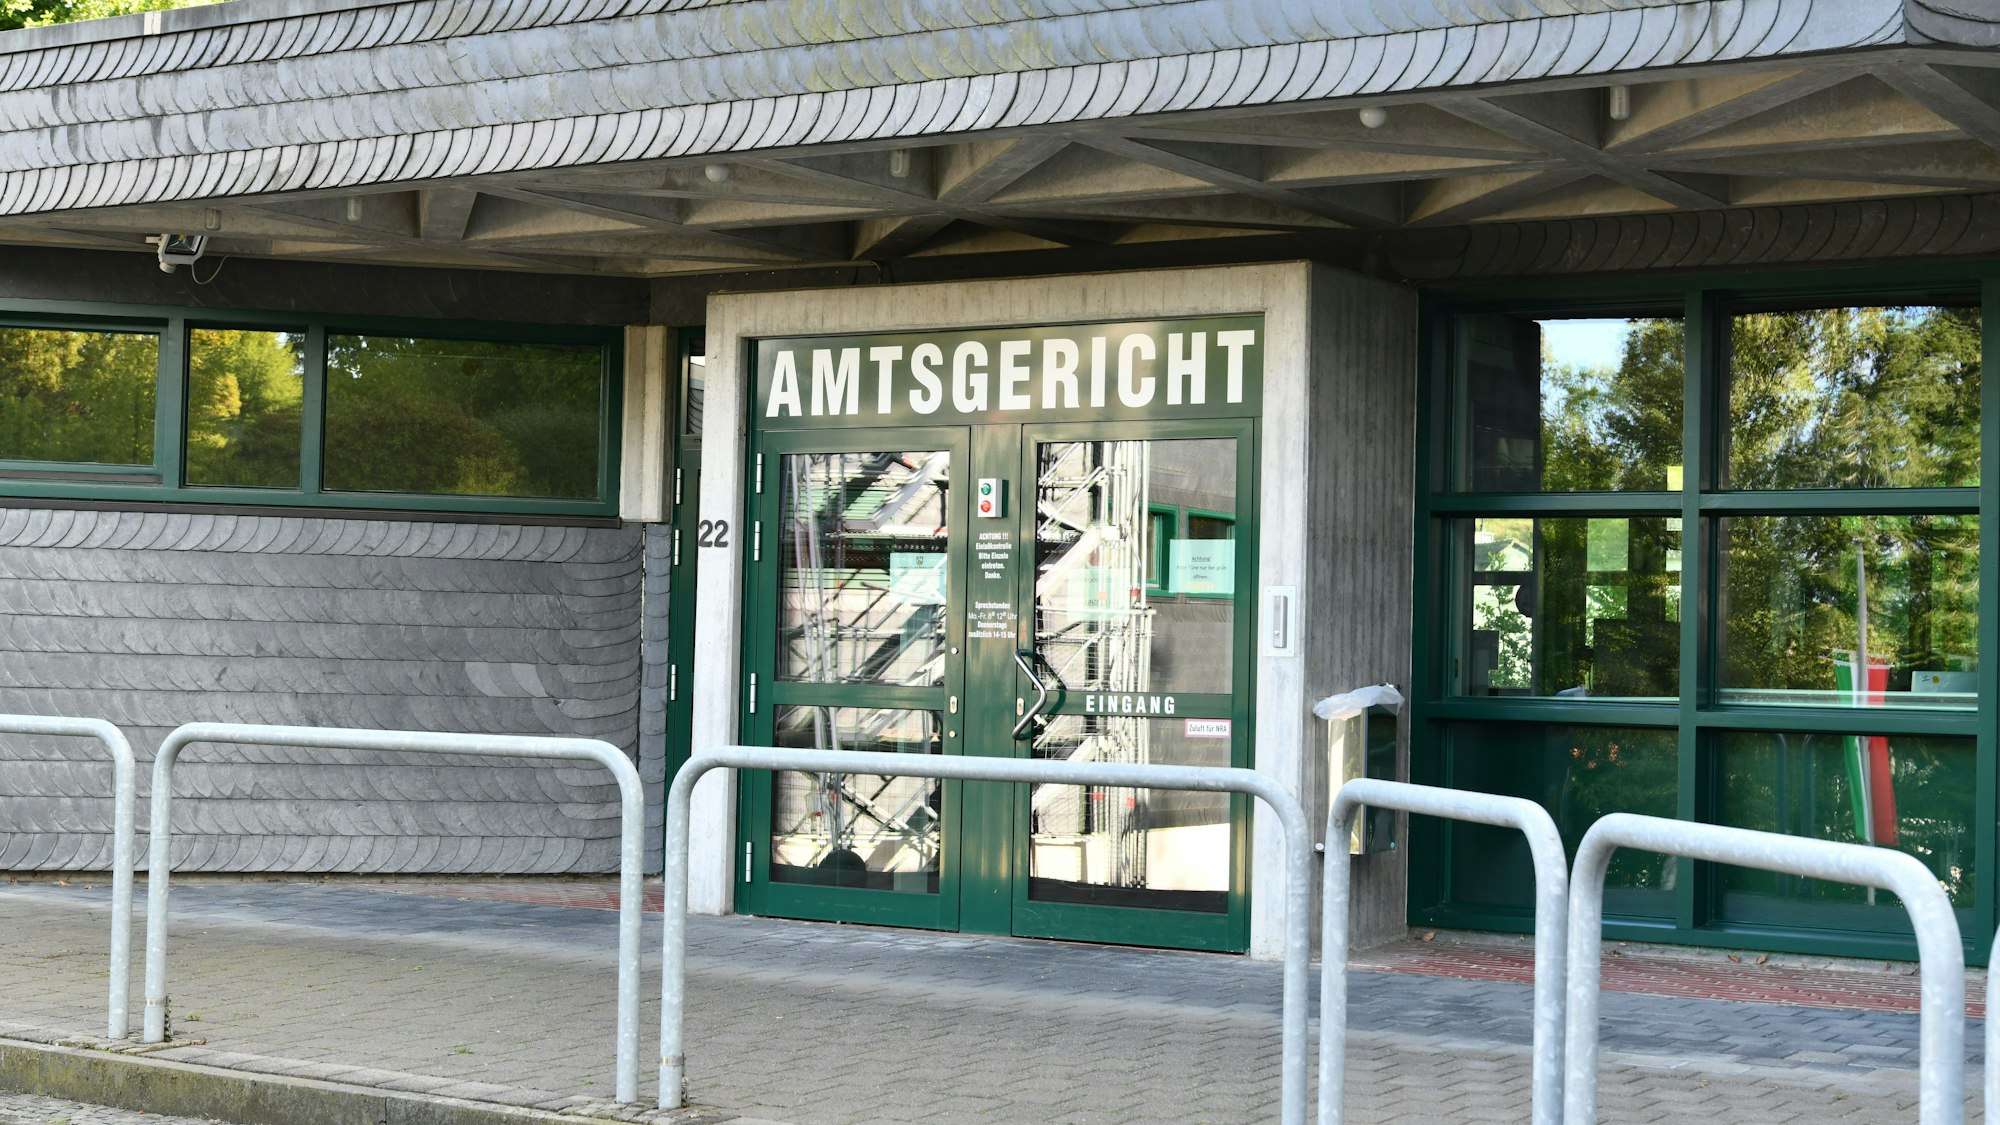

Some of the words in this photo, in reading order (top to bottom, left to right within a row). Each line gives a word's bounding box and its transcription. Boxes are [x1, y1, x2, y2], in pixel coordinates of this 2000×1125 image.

[766, 329, 1256, 418] AMTSGERICHT
[698, 519, 729, 548] 22
[979, 532, 1002, 540] ACHTUNG
[978, 552, 990, 560] Bitte
[984, 571, 1002, 579] Danke.
[975, 601, 1011, 610] Sprechstunden
[1007, 612, 1018, 620] Uhr
[977, 620, 1007, 630] Donnerstags
[1007, 631, 1016, 639] Uhr
[1085, 694, 1176, 714] EINGANG
[1188, 724, 1205, 732] Zuluft
[1206, 724, 1214, 732] für
[1215, 724, 1227, 732] NRA
